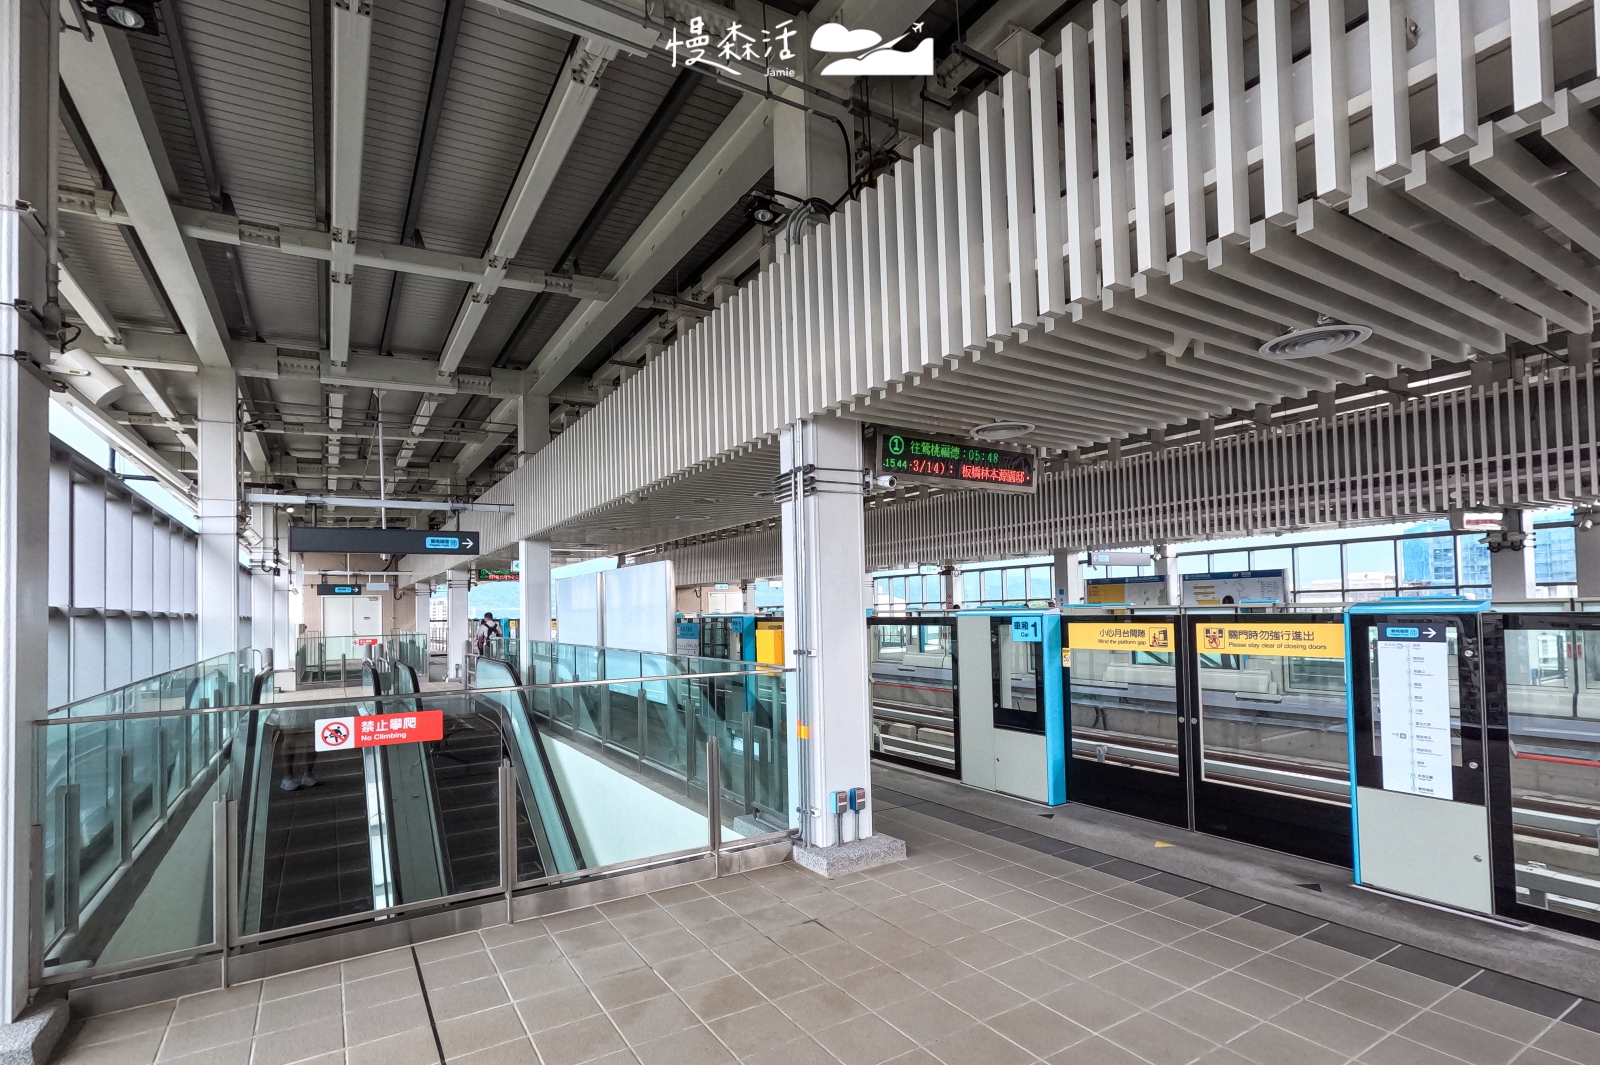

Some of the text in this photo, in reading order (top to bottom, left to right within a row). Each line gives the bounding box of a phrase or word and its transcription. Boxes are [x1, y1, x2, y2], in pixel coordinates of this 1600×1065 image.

[1013, 621, 1038, 638] 車廂 1
[1099, 628, 1146, 638] 小心月台間隙
[361, 717, 417, 733] 禁止攀爬
[373, 732, 407, 741] Climbing
